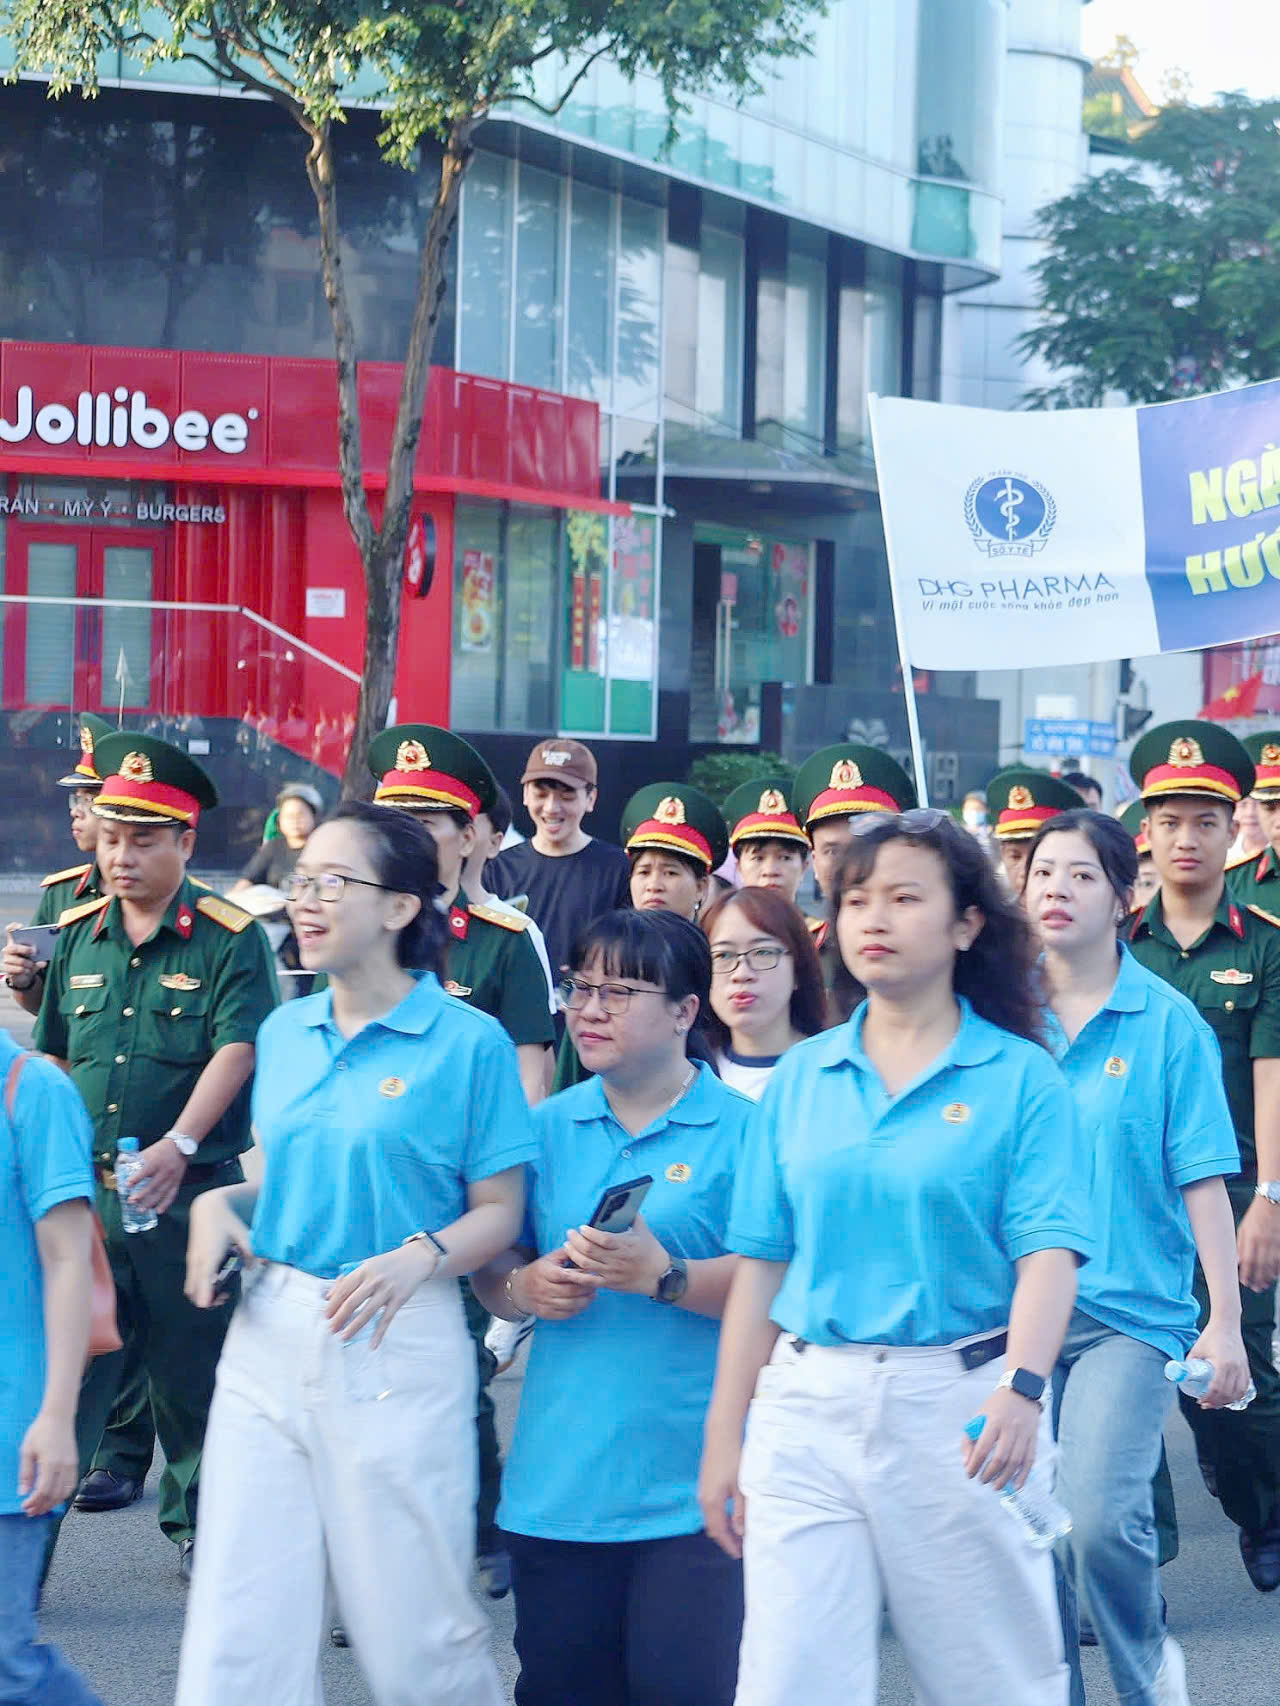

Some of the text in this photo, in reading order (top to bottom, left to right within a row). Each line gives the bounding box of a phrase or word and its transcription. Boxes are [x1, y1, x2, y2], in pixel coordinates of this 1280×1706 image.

[0, 385, 249, 454] Jollibee
[136, 503, 226, 524] BURGERS
[918, 571, 1116, 600] DHG PHARMA
